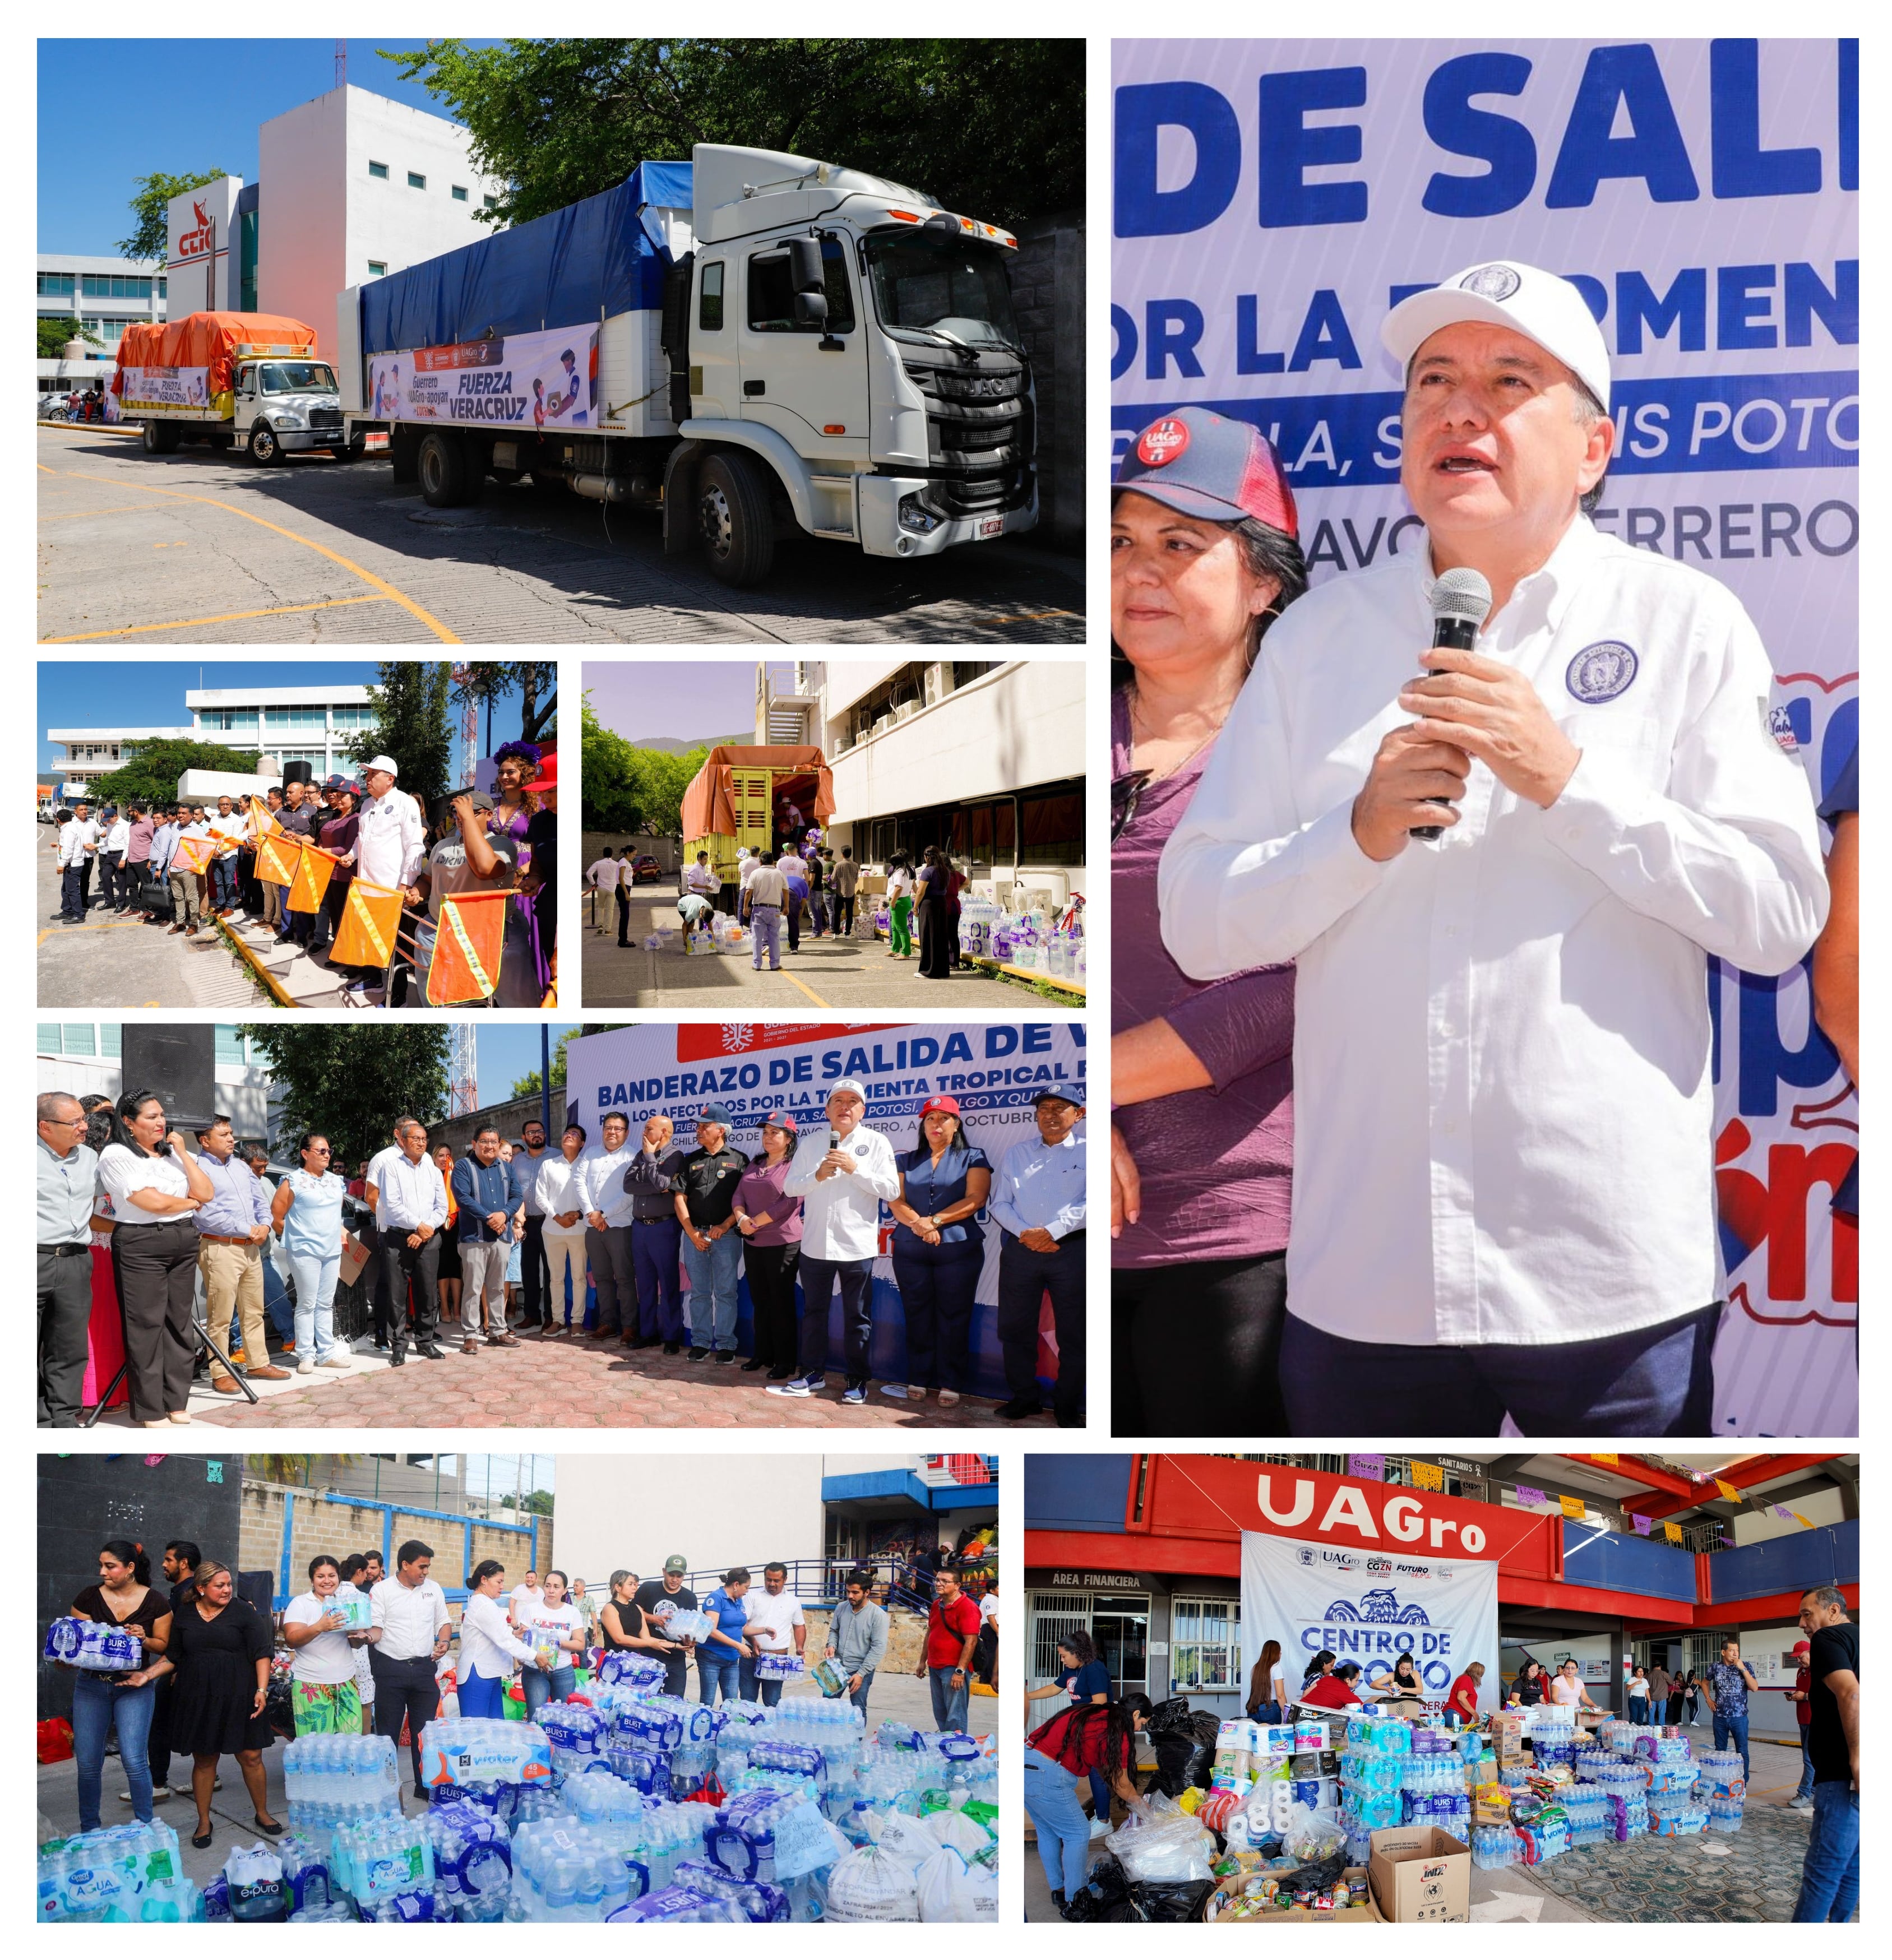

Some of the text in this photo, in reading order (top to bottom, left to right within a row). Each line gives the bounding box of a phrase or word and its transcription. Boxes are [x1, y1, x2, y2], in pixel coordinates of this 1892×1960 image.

[1114, 65, 1368, 238] DE
[1237, 289, 1362, 375] LA
[461, 347, 478, 357] UAGro
[413, 376, 437, 388] Guerrero
[458, 371, 512, 395] FUERZA
[965, 377, 1003, 395] JAC
[159, 392, 187, 402] VERACRUZ
[427, 391, 448, 405] apoyan
[450, 397, 528, 420] VERACRUZ
[1146, 431, 1182, 443] UAGro
[598, 1063, 761, 1108] BANDERAZO
[769, 1055, 813, 1086] DE
[821, 1032, 973, 1079] SALIDA
[985, 1023, 1052, 1059] DE
[633, 1108, 656, 1122] LOS
[751, 1095, 784, 1110] POR
[789, 1092, 811, 1106] LA
[936, 1063, 1068, 1091] TROPICAL
[868, 1100, 919, 1116] POTOSÍ,
[994, 1095, 1004, 1105] Y
[747, 1132, 760, 1141] DE
[907, 1122, 917, 1131] A
[1438, 1457, 1473, 1473] SANITARIOS
[1257, 1474, 1486, 1553] UAGro
[1324, 1551, 1360, 1565] UAGro
[1367, 1563, 1392, 1572] CGZN
[1396, 1564, 1428, 1574] FUTURO
[1053, 1573, 1140, 1587] ÁREA FINANCIERA
[1301, 1627, 1451, 1655] CENTRO DE
[624, 1718, 643, 1729] BURST
[545, 1726, 568, 1738] BURST
[473, 1755, 519, 1766] water
[440, 1787, 465, 1799] BURST
[735, 1794, 758, 1809] BURST
[77, 1879, 113, 1896] AGUA
